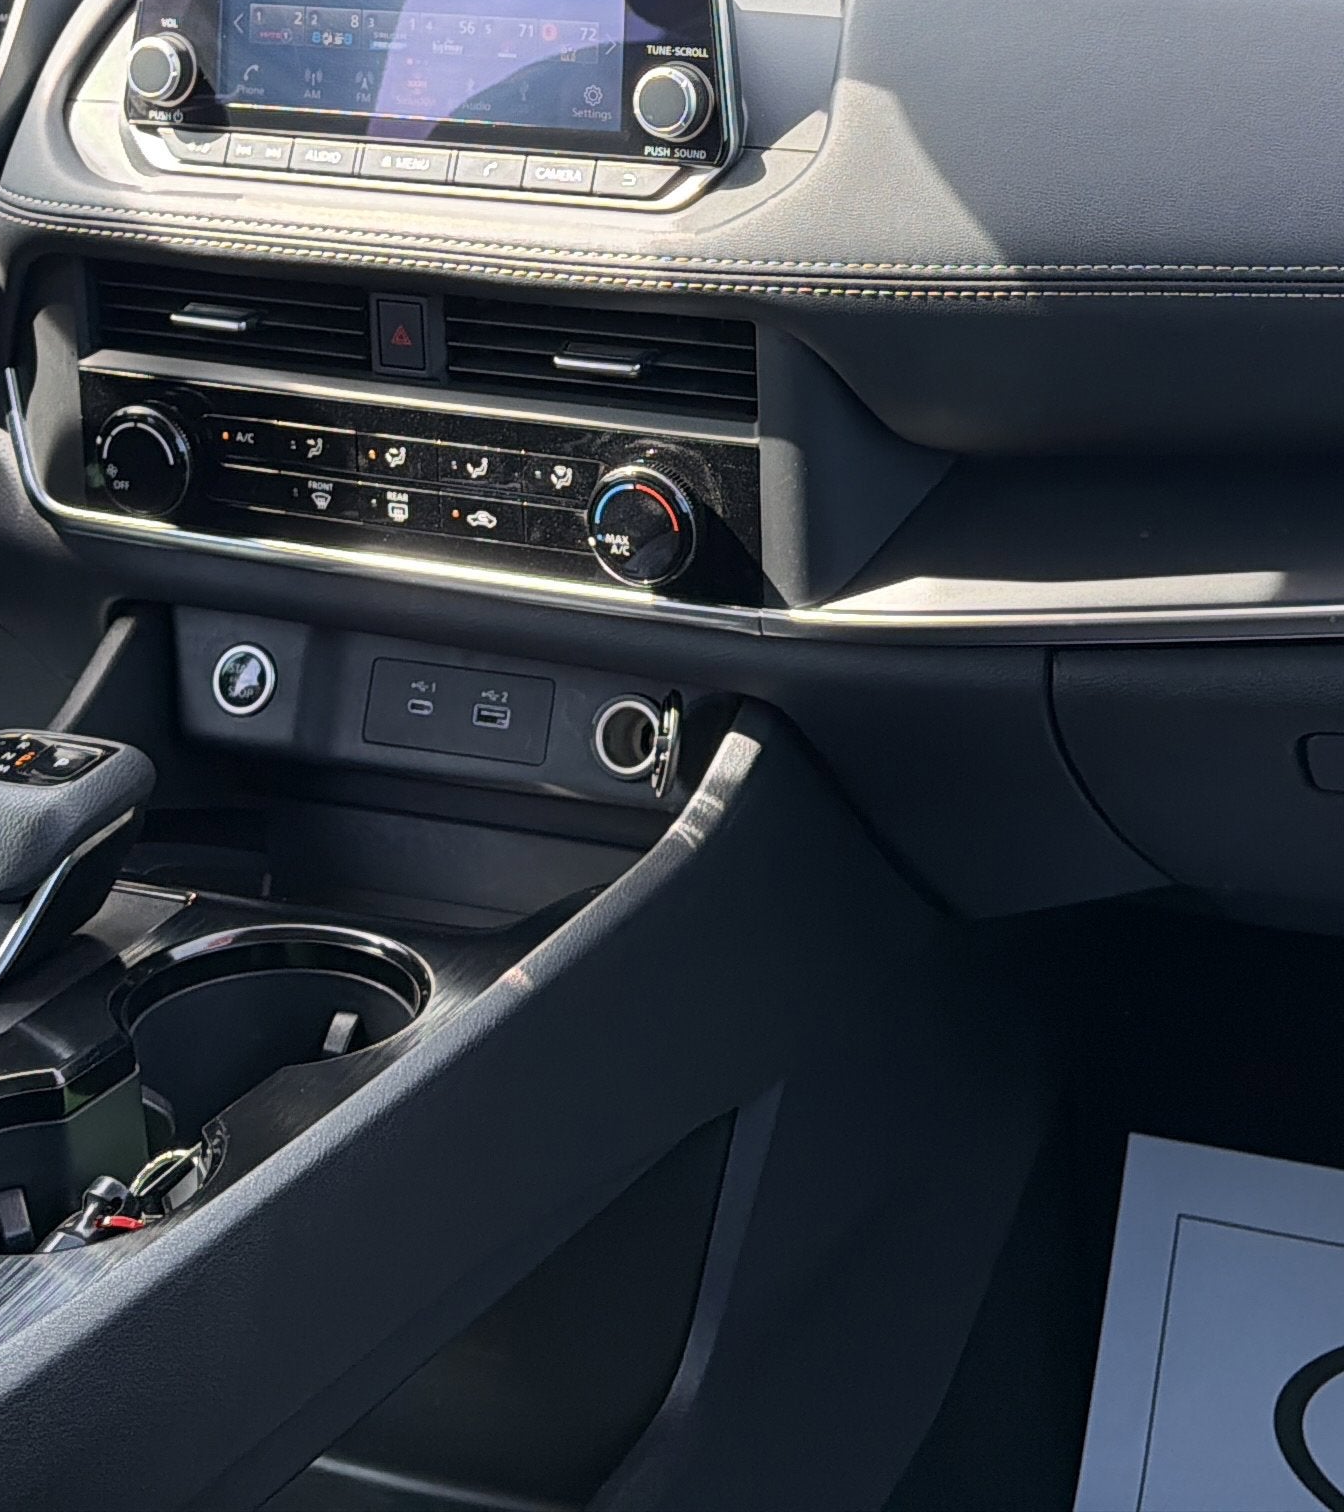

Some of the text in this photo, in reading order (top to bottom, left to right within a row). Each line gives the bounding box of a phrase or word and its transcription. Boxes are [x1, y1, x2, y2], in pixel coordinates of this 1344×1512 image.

[294, 11, 303, 25] 2
[310, 14, 359, 28] 2 8
[368, 17, 375, 28] 3
[459, 20, 476, 34] 56
[519, 24, 534, 37] 71
[580, 27, 598, 41] 72
[237, 85, 265, 96] Phone
[304, 90, 321, 99] AM
[356, 93, 371, 103] FM
[148, 110, 172, 121] PUSH
[572, 106, 613, 122] Settings
[304, 150, 342, 164] AUDIO
[644, 146, 707, 159] PUSH SOUND
[395, 157, 431, 171] MENU
[535, 167, 582, 183] CAMERA
[236, 431, 255, 444] A/C
[113, 479, 129, 490] OFF
[307, 480, 333, 491] FRONT
[386, 491, 409, 502] REAR
[604, 533, 630, 545] MAX
[610, 544, 631, 556] A/C
[501, 691, 509, 703] 2
[0, 751, 17, 760] N
[53, 757, 70, 768] P
